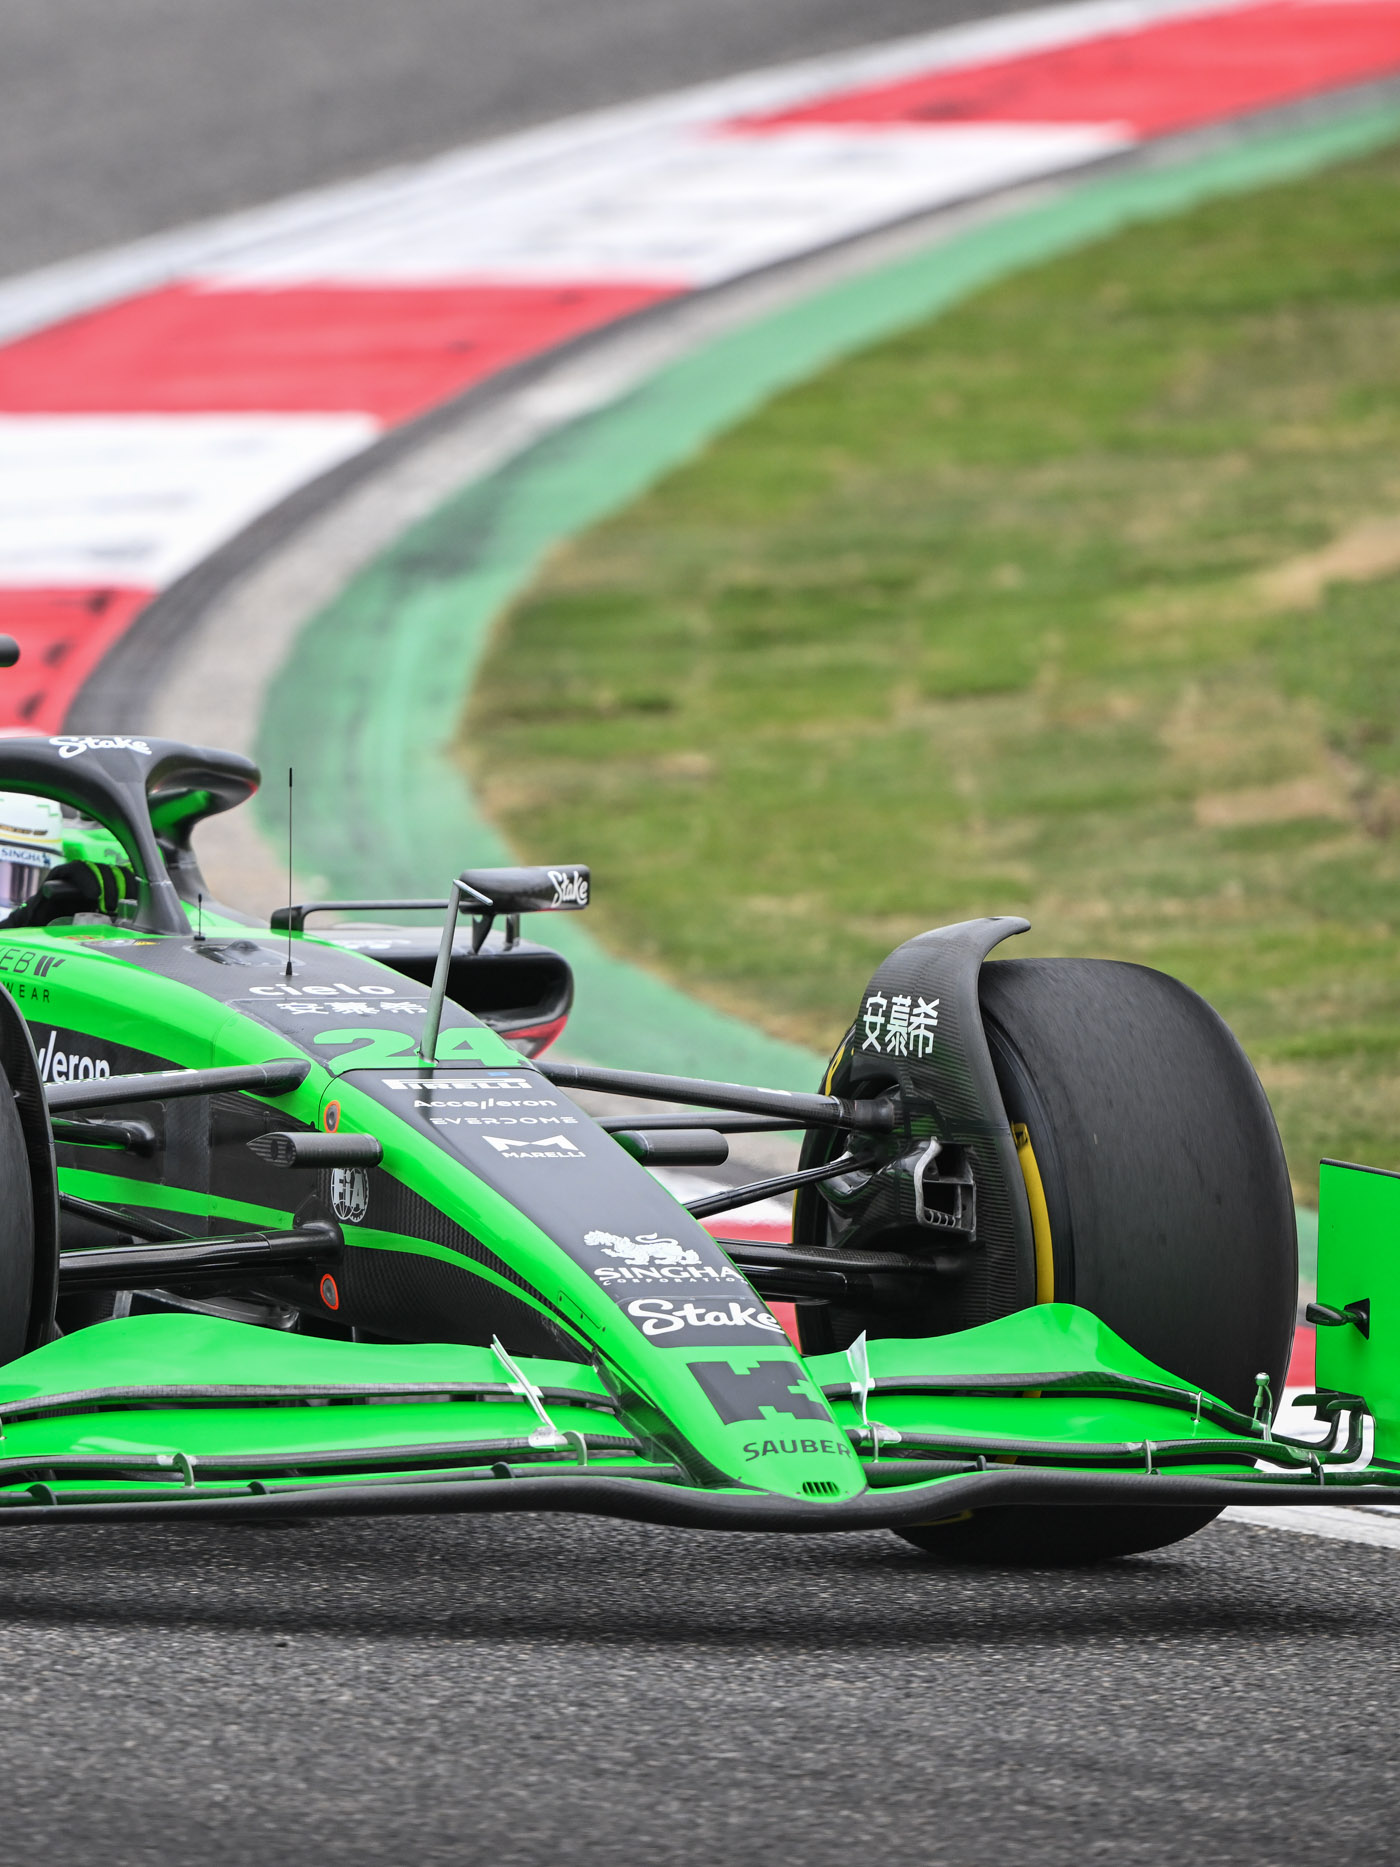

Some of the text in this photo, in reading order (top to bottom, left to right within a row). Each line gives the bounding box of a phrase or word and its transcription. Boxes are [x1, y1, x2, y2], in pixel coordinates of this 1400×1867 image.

[50, 736, 152, 758] Stake
[547, 870, 588, 908] Stake
[249, 984, 396, 995] cielo
[861, 991, 940, 1058] 安慕希
[313, 1027, 524, 1068] 24
[381, 1078, 533, 1090] PIRELLI
[413, 1098, 557, 1110] Accelleron
[429, 1116, 579, 1125] EVERDOME
[593, 1266, 744, 1281] SINGHA
[627, 1298, 787, 1336] Stake
[743, 1439, 852, 1462] SAUBER
